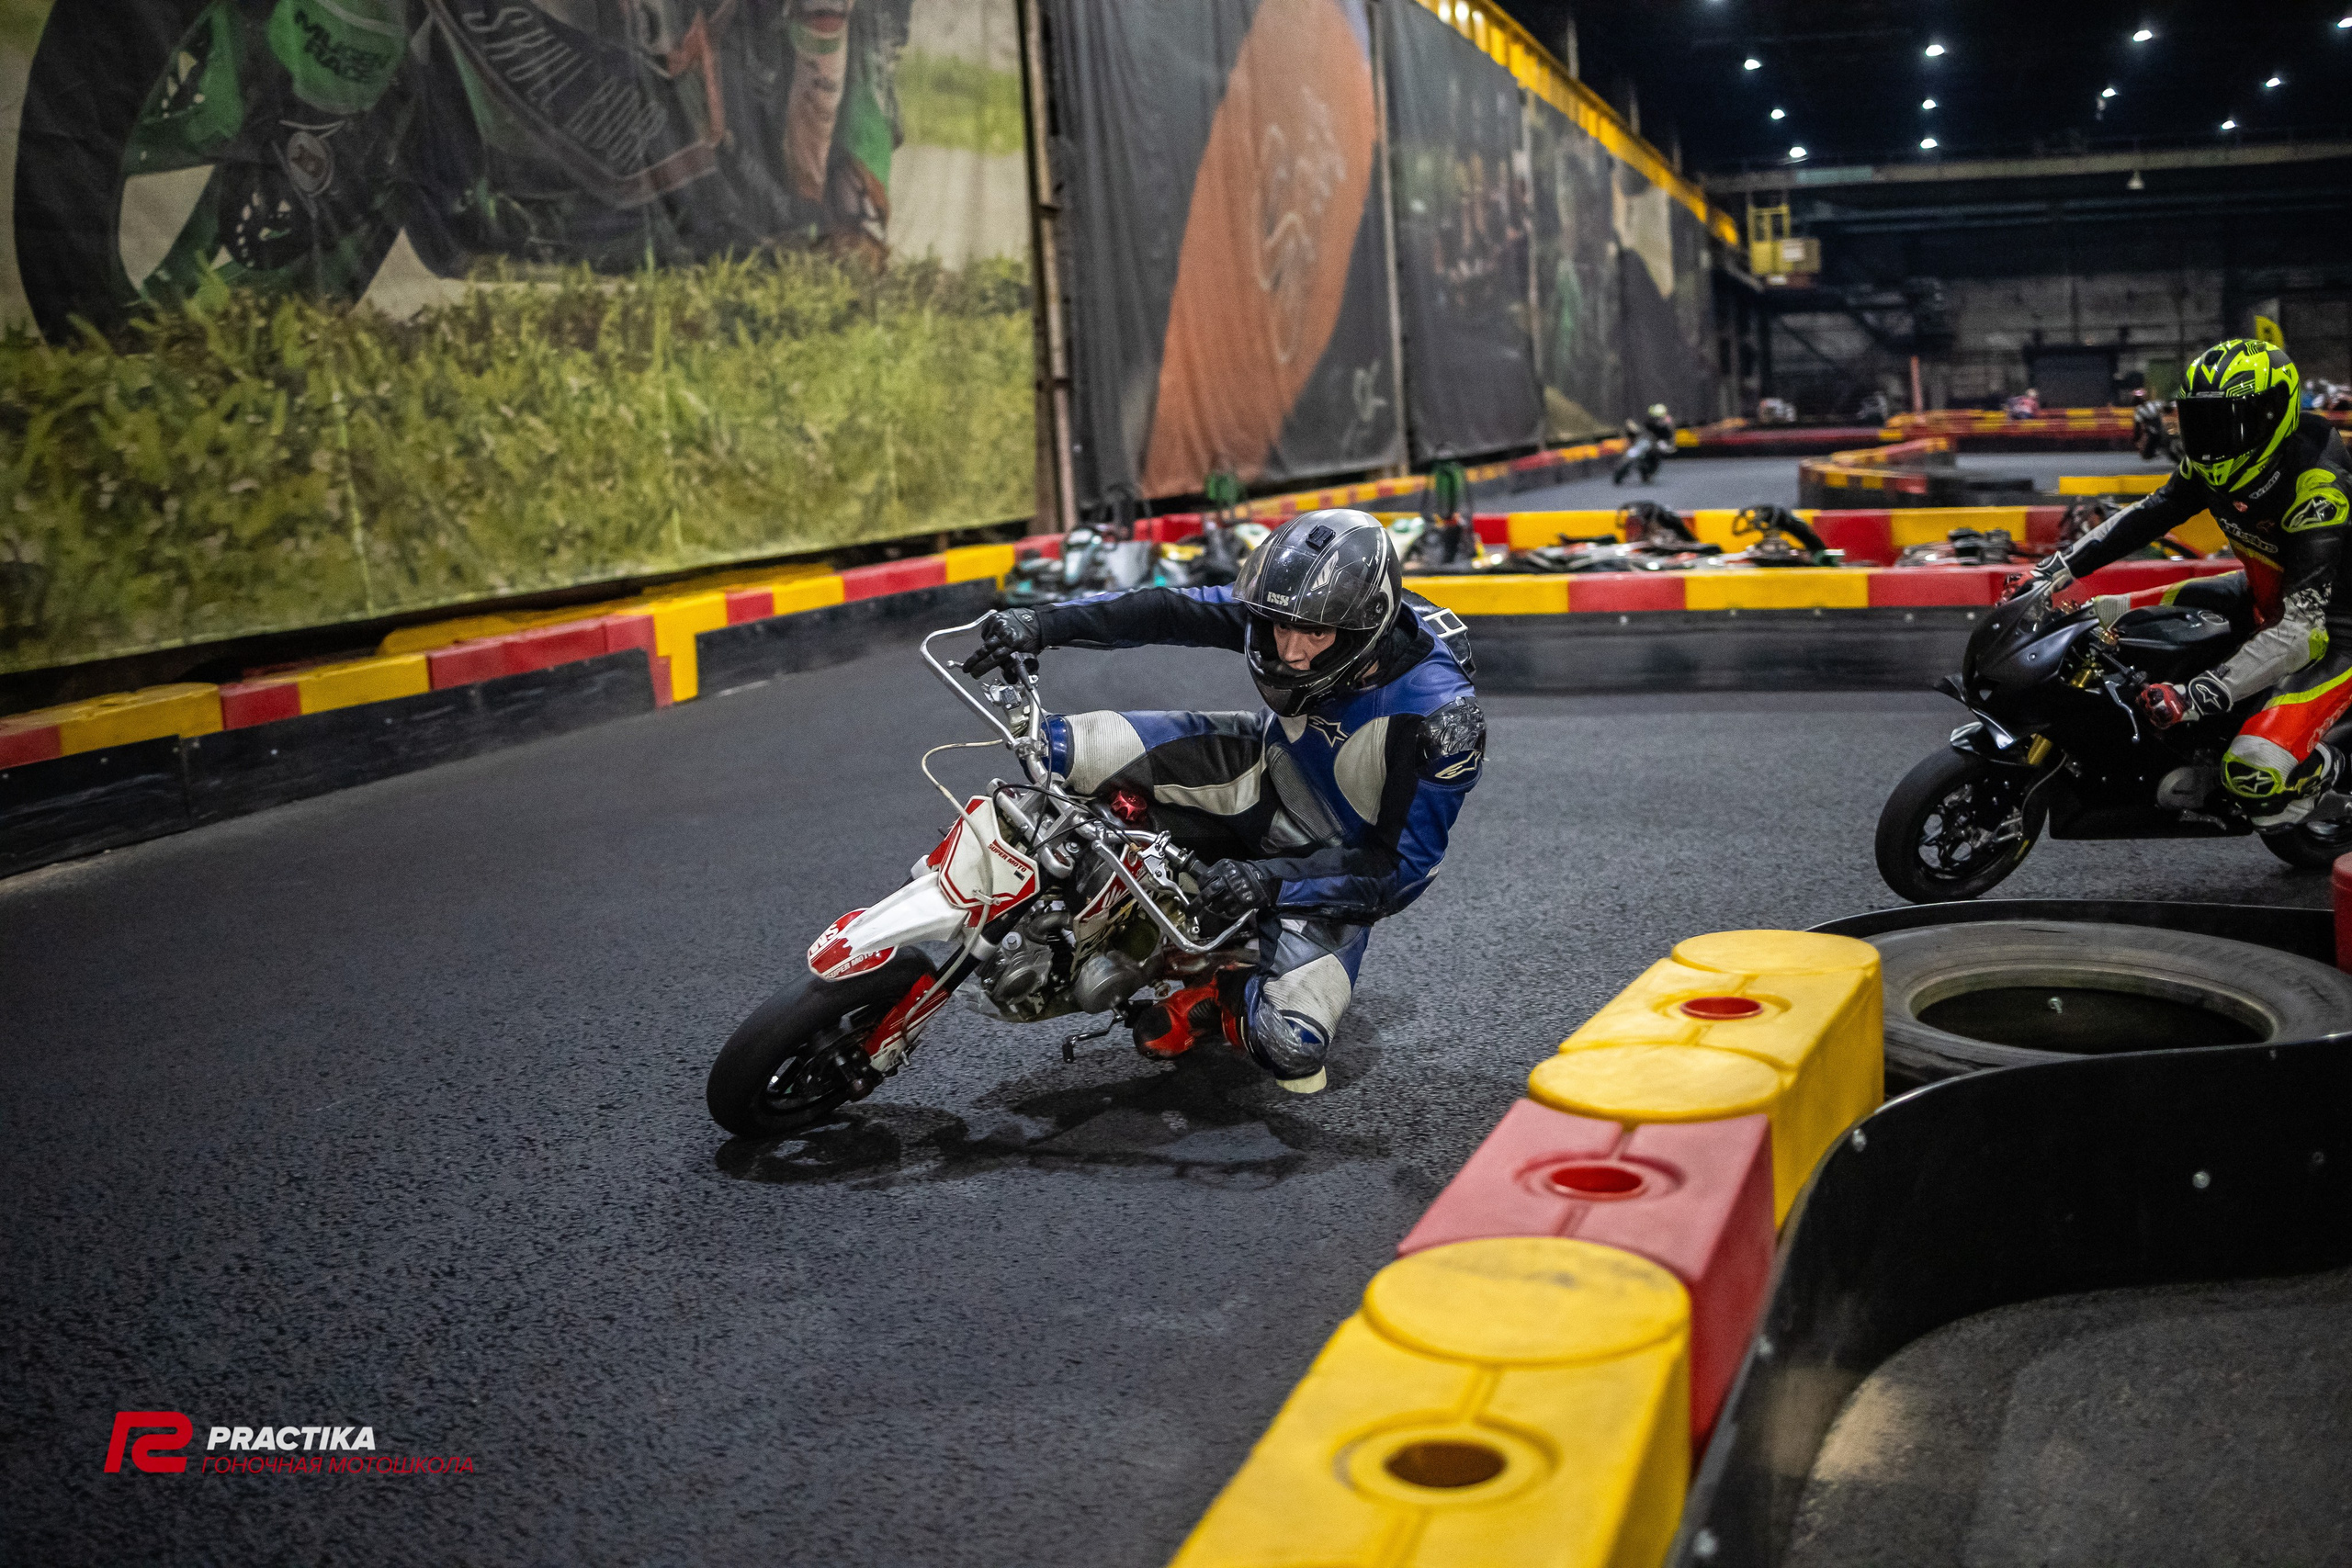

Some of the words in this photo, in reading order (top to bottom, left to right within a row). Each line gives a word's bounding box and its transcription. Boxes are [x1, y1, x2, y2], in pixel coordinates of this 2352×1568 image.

[462, 6, 594, 114] SKULL
[988, 842, 1008, 862] SUPER
[1007, 857, 1027, 873] MOTO
